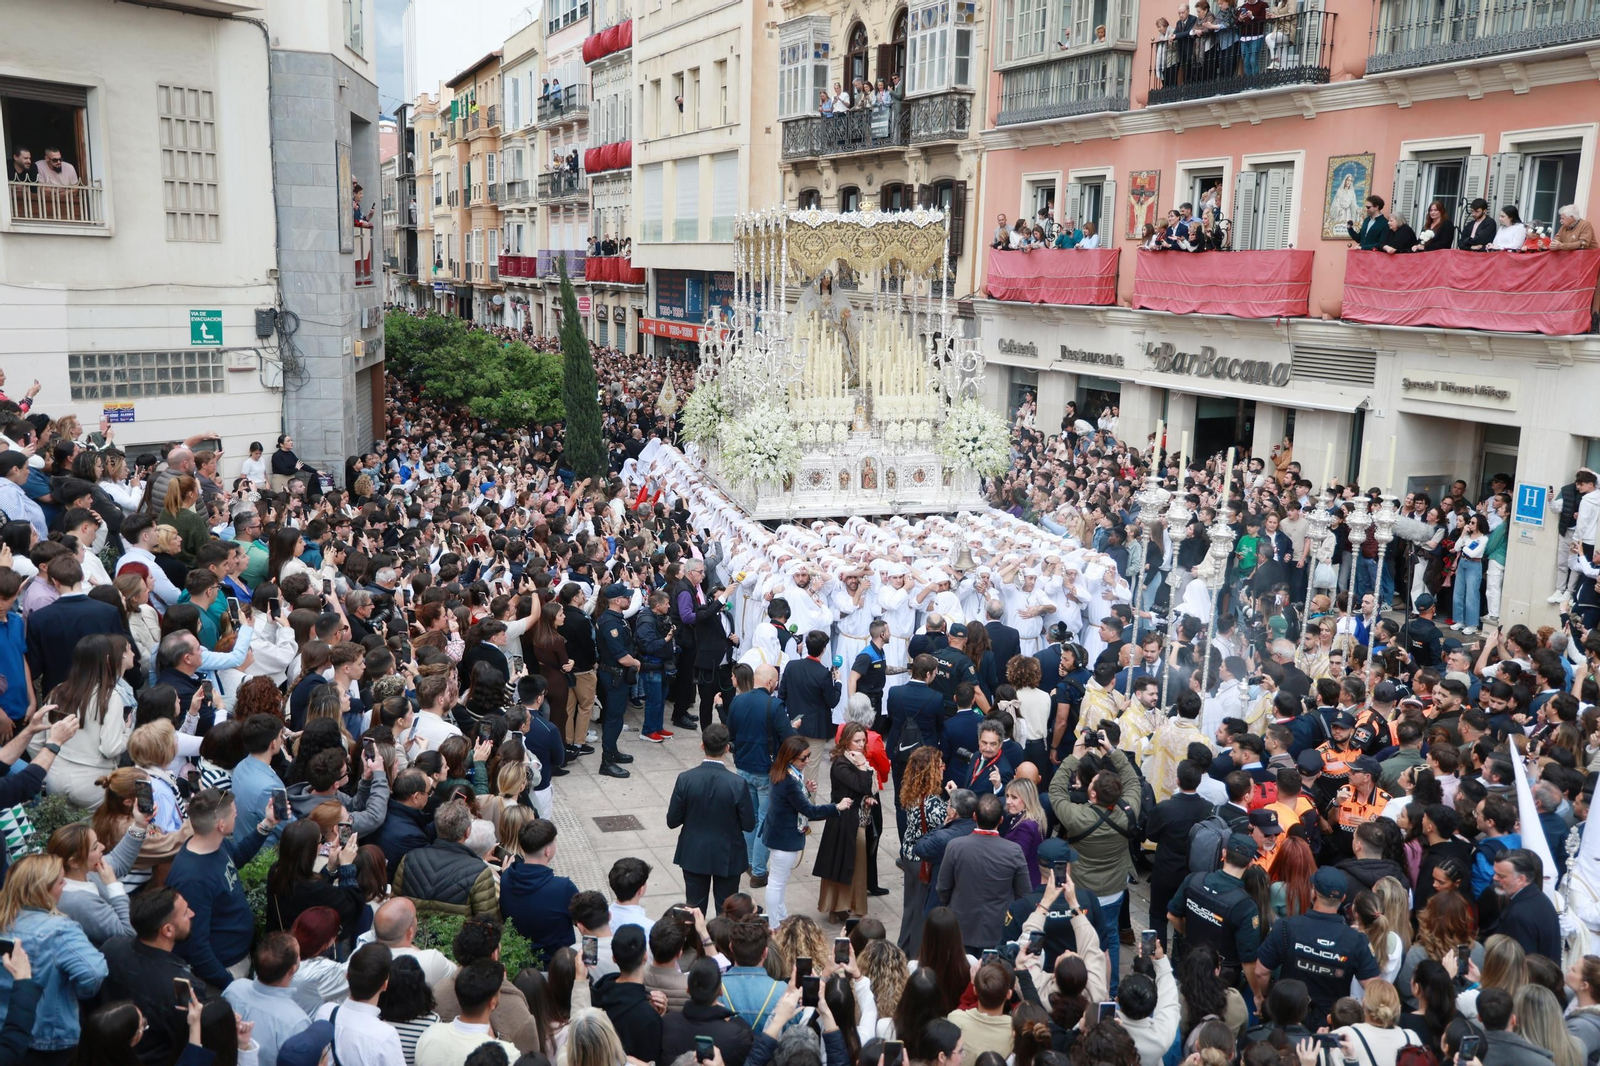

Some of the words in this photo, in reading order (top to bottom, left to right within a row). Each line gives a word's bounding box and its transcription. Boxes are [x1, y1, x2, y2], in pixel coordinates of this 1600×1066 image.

[1060, 345, 1125, 367] Restaurante
[1523, 488, 1540, 508] H
[1295, 943, 1341, 962] POLICIA
[1297, 960, 1334, 976] U.I.P.
